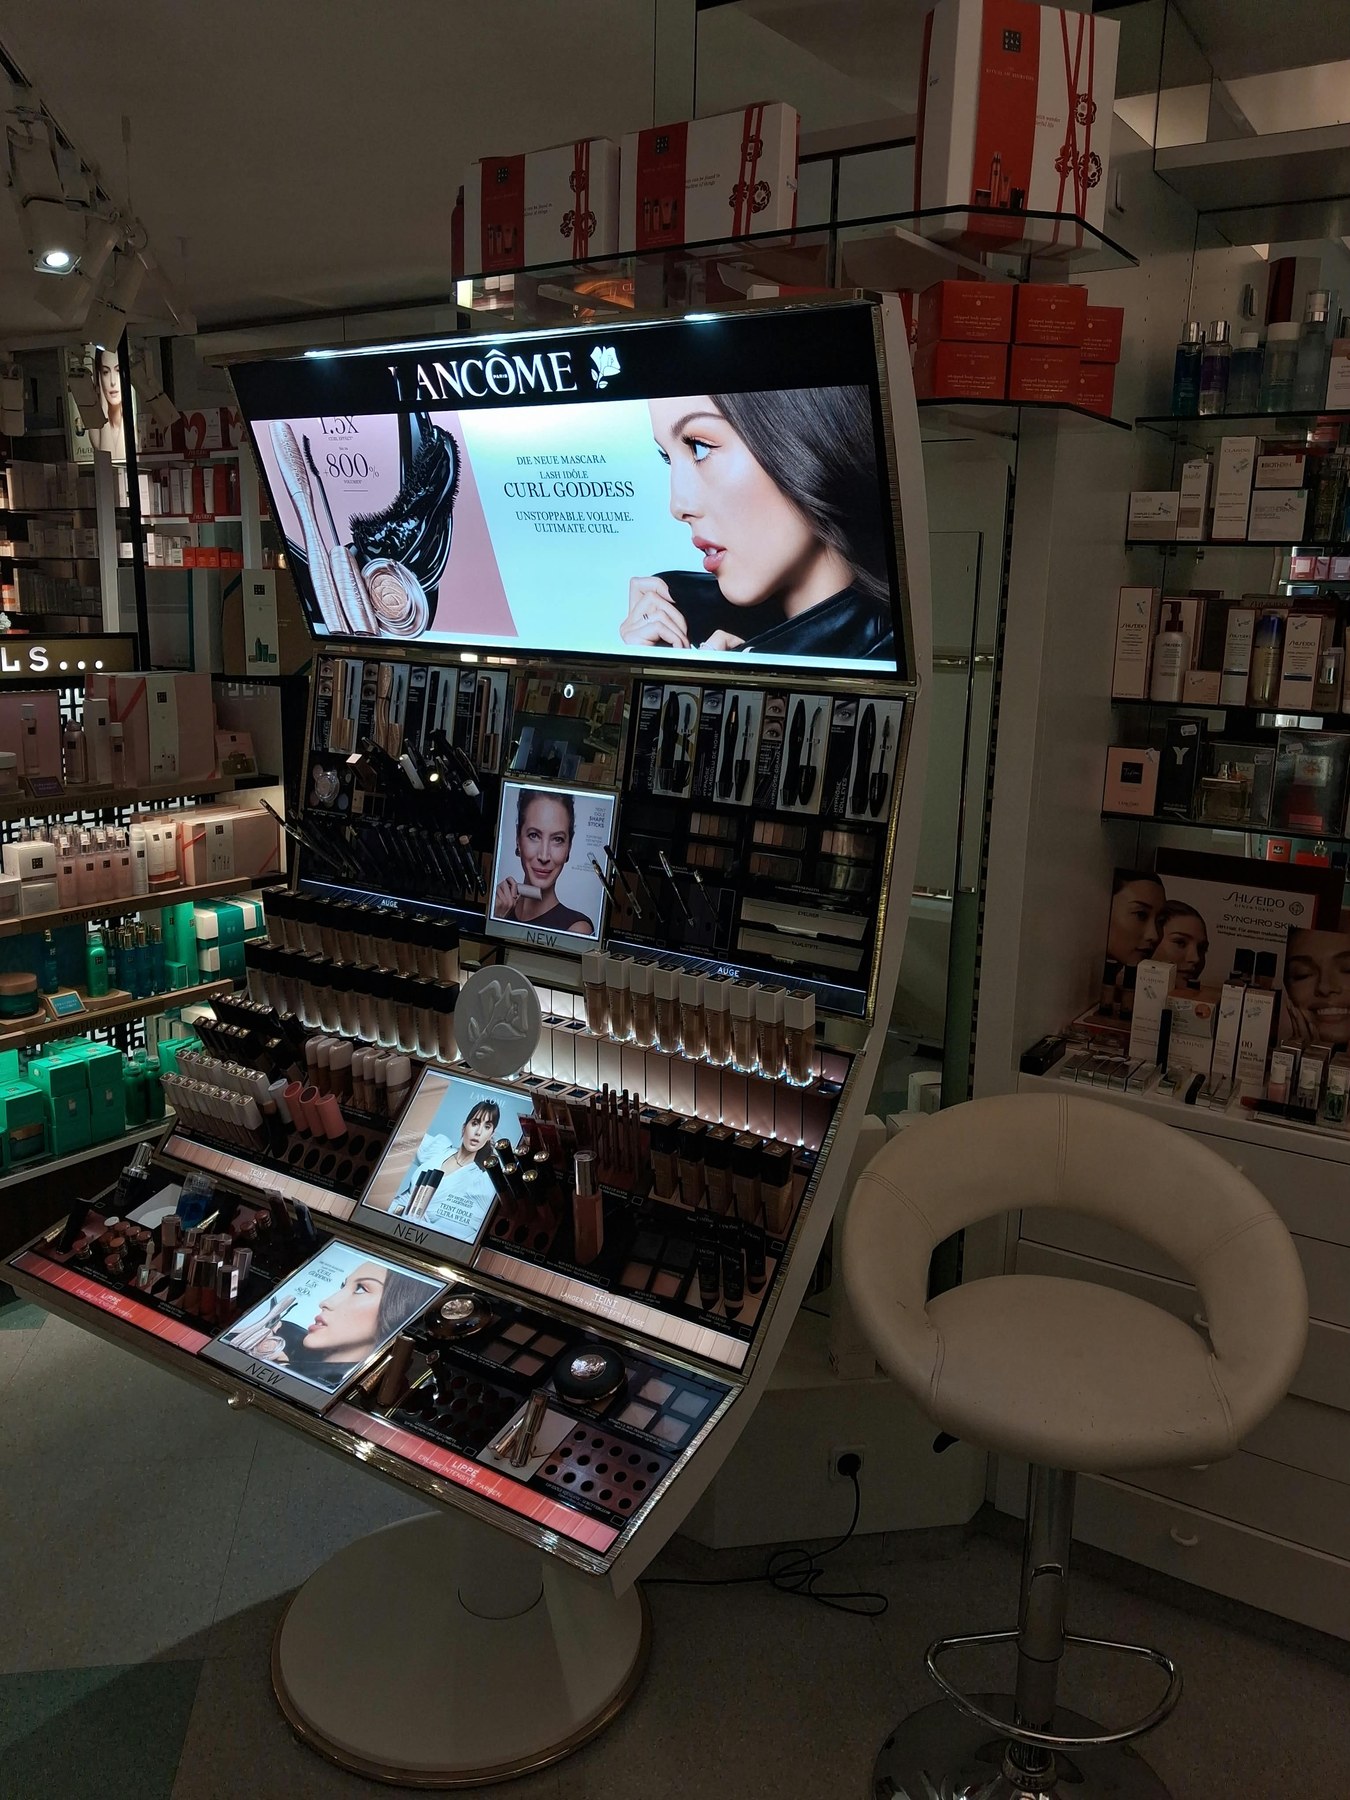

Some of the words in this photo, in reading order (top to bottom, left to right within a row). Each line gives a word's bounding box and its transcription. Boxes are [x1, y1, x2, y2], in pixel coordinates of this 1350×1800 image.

[516, 456, 533, 465] DIE
[533, 455, 560, 465] NEUE
[560, 454, 607, 464] MASCARA
[539, 470, 562, 479] LASH
[562, 469, 589, 479] IDÔLE
[503, 482, 551, 498] CURL
[553, 481, 635, 498] GODDESS
[515, 511, 586, 521] UNSTOPPABLE
[586, 511, 634, 522] VOLUME.
[534, 523, 587, 533] ULTIMATE
[587, 523, 619, 534] CURL.
[1172, 746, 1190, 765] Y
[381, 899, 399, 909] AUGE
[1222, 891, 1285, 909] SHISEIDO
[1223, 914, 1273, 928] SYNCHRO
[526, 930, 558, 947] NEW
[717, 966, 740, 979] AUGE
[1171, 1038, 1205, 1049] CLARINS
[436, 1208, 455, 1220] ULTRA
[453, 1213, 471, 1225] WEAR
[439, 1202, 458, 1214] TEINT
[456, 1206, 473, 1219] IDOLE
[393, 1223, 429, 1245] NEW
[584, 1298, 600, 1310] HALT
[593, 1293, 618, 1308] TEINT
[245, 1362, 286, 1385] NEW
[417, 1453, 442, 1471] ERLEBE
[441, 1465, 476, 1487] INTENSIVE
[475, 1481, 503, 1499] FARBEN
[451, 1459, 478, 1479] LIPPE
